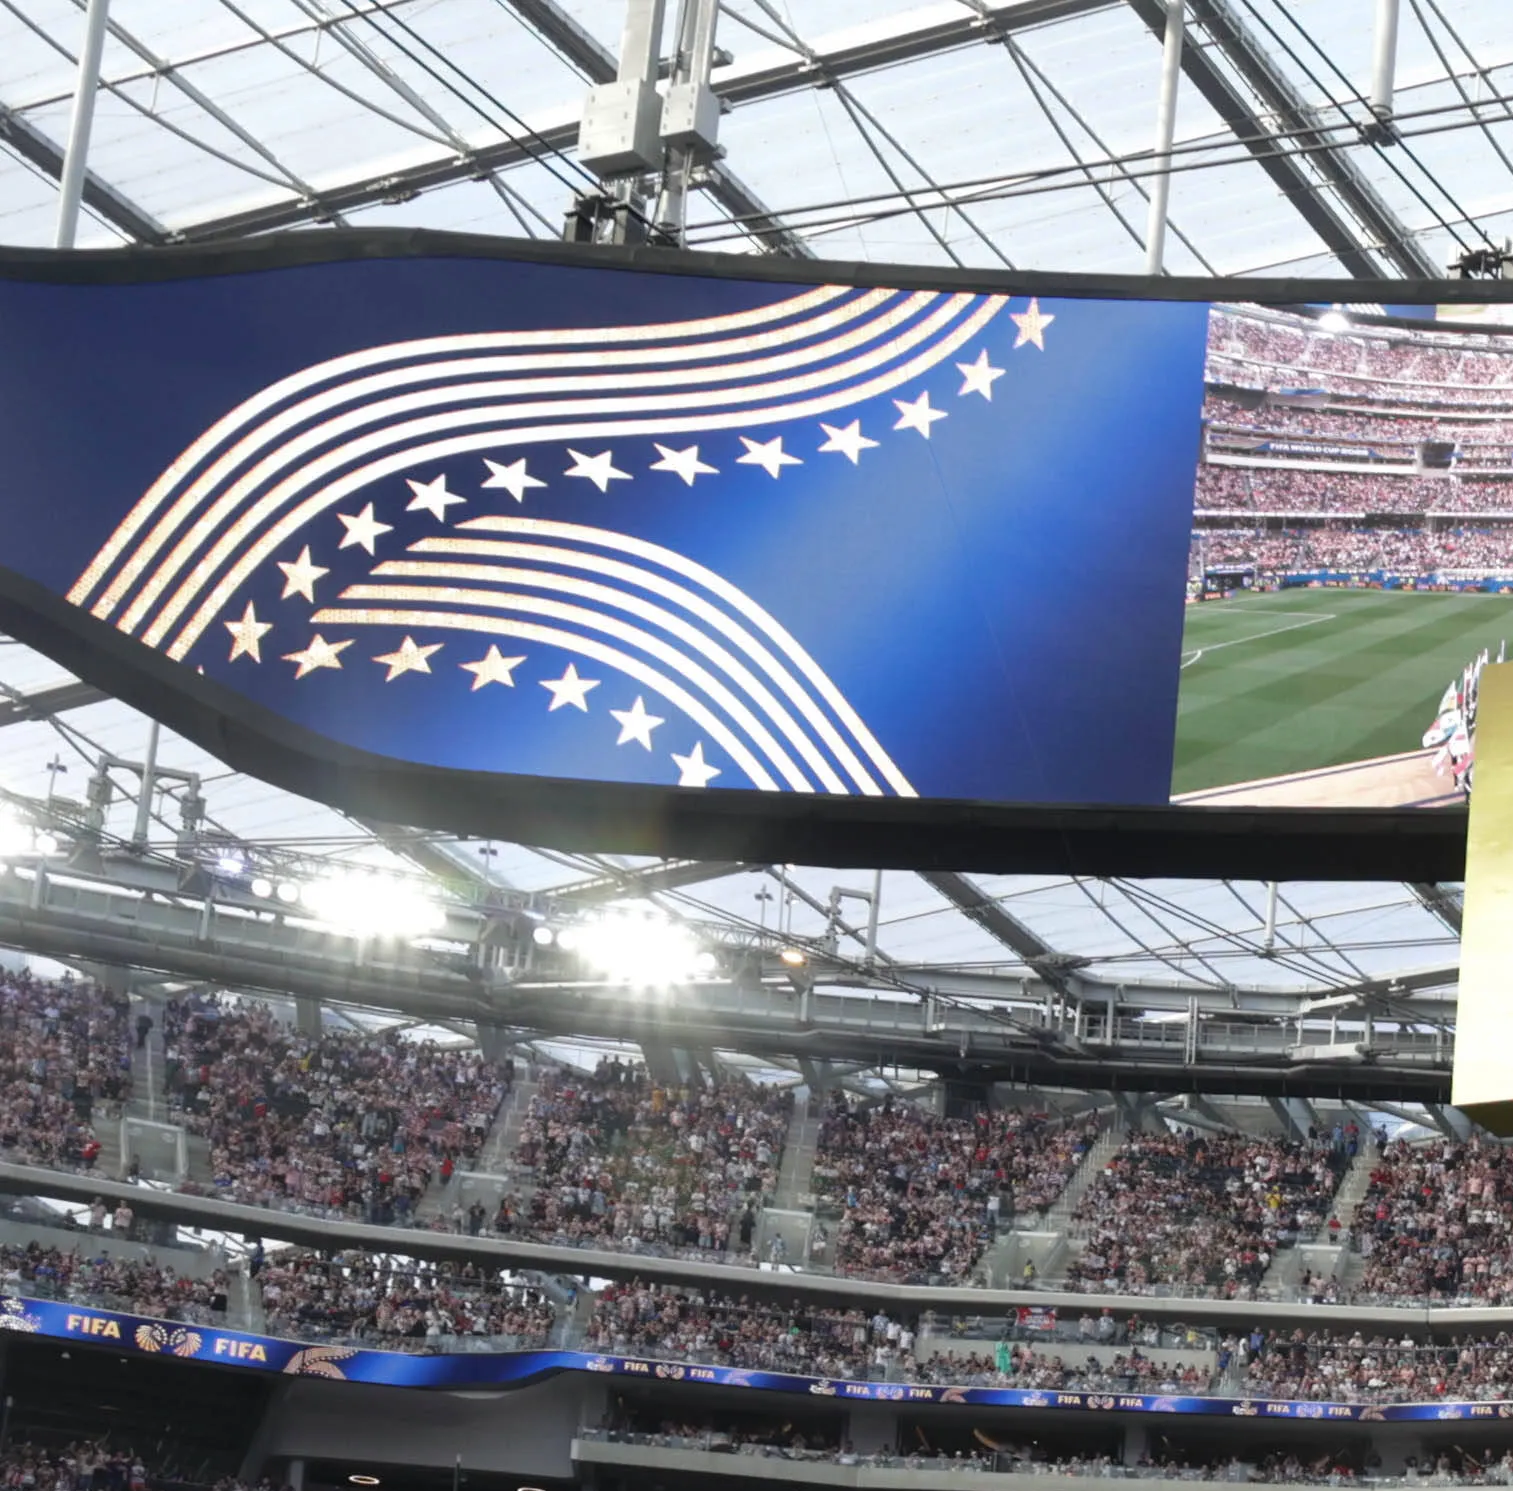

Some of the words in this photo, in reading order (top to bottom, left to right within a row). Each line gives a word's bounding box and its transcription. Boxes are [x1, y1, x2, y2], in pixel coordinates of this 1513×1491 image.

[66, 1314, 120, 1338] FIFA
[214, 1338, 266, 1361] FIFA
[624, 1362, 648, 1372] FIFA
[690, 1368, 714, 1379] FIFA
[846, 1385, 870, 1395] FIFA
[909, 1388, 932, 1398] FIFA
[1058, 1395, 1080, 1404] FIFA
[1120, 1398, 1143, 1407] FIFA
[1267, 1404, 1290, 1414] FIFA
[1328, 1406, 1351, 1416] FIFA
[1470, 1406, 1492, 1415] FIFA
